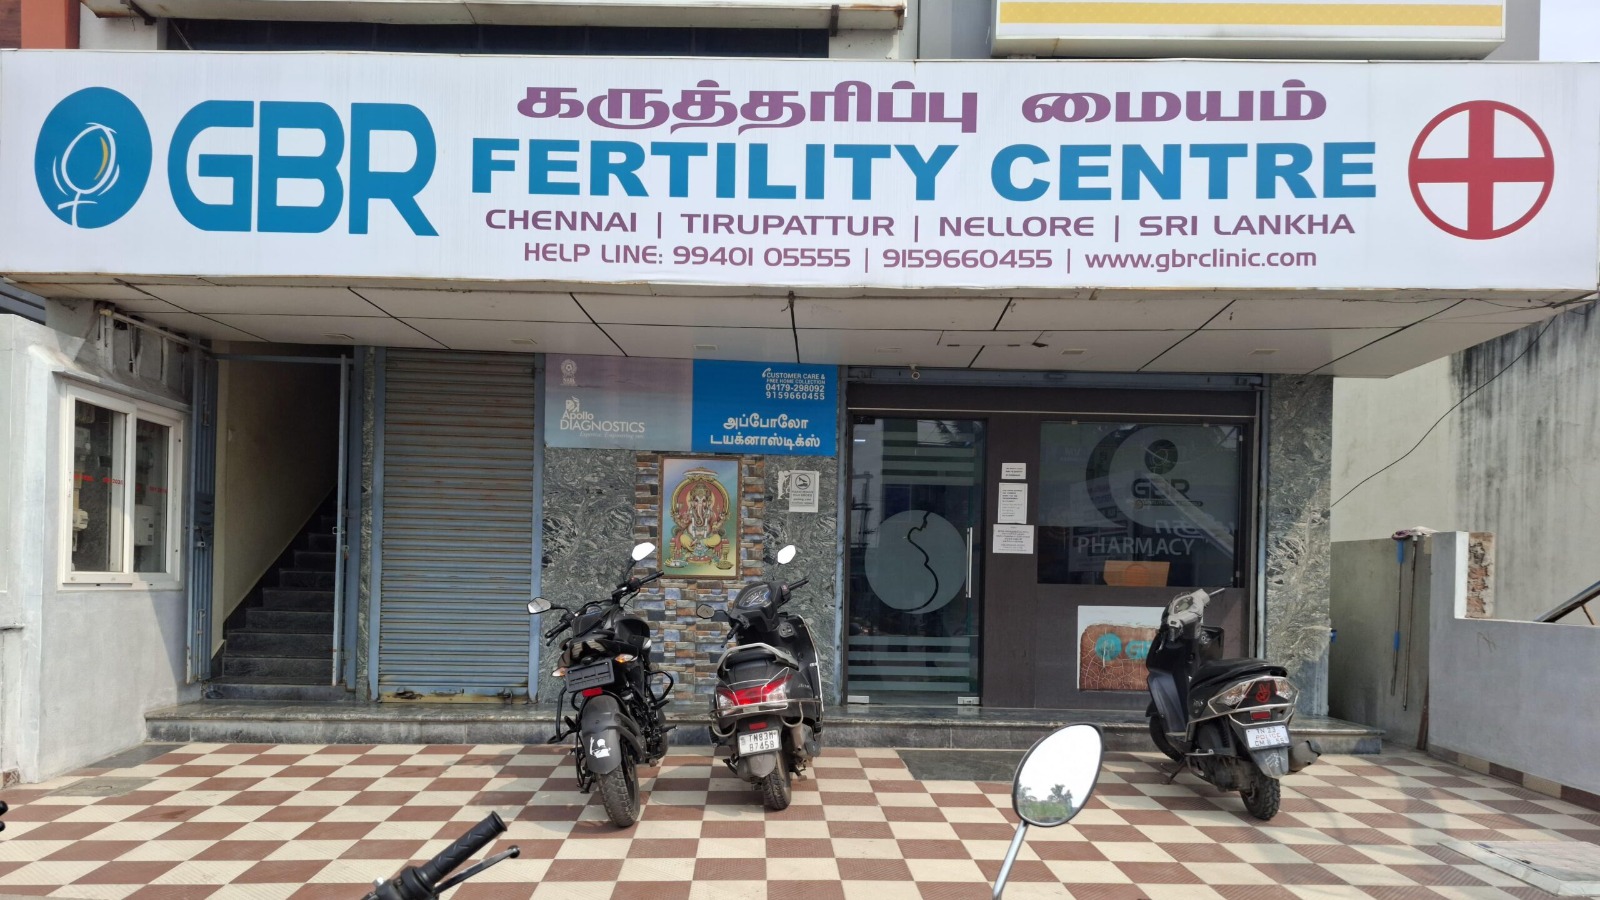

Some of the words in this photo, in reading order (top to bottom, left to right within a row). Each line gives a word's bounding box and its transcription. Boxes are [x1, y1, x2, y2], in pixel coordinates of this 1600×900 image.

[517, 79, 978, 136] கருத்தரிப்பு
[1021, 78, 1327, 124] மையம்
[167, 99, 440, 236] GBR
[471, 137, 959, 201] FERTILITY
[990, 141, 1377, 201] CENTRE
[485, 209, 637, 233] CHENNAI
[680, 213, 895, 237] TIRUPATTUR
[939, 216, 1094, 237] NELLORE
[1139, 215, 1198, 236] SRI
[1214, 213, 1356, 235] LANKHA
[524, 242, 591, 263] HELP
[601, 244, 663, 265] LINE:
[672, 245, 753, 266] 99401
[763, 247, 851, 268] 05555
[882, 248, 1053, 269] 9159660455
[1085, 248, 1317, 273] www.gbrclinic.com
[765, 383, 825, 393] 04179-298092
[765, 391, 825, 400] 9159660455
[562, 409, 594, 420] Apollo
[723, 412, 809, 430] அப்போலோ
[560, 419, 645, 433] DIAGNOSTICS
[710, 431, 821, 450] டயக்னாஸ்டிக்ஸ்
[1078, 537, 1195, 556] PHARMACY
